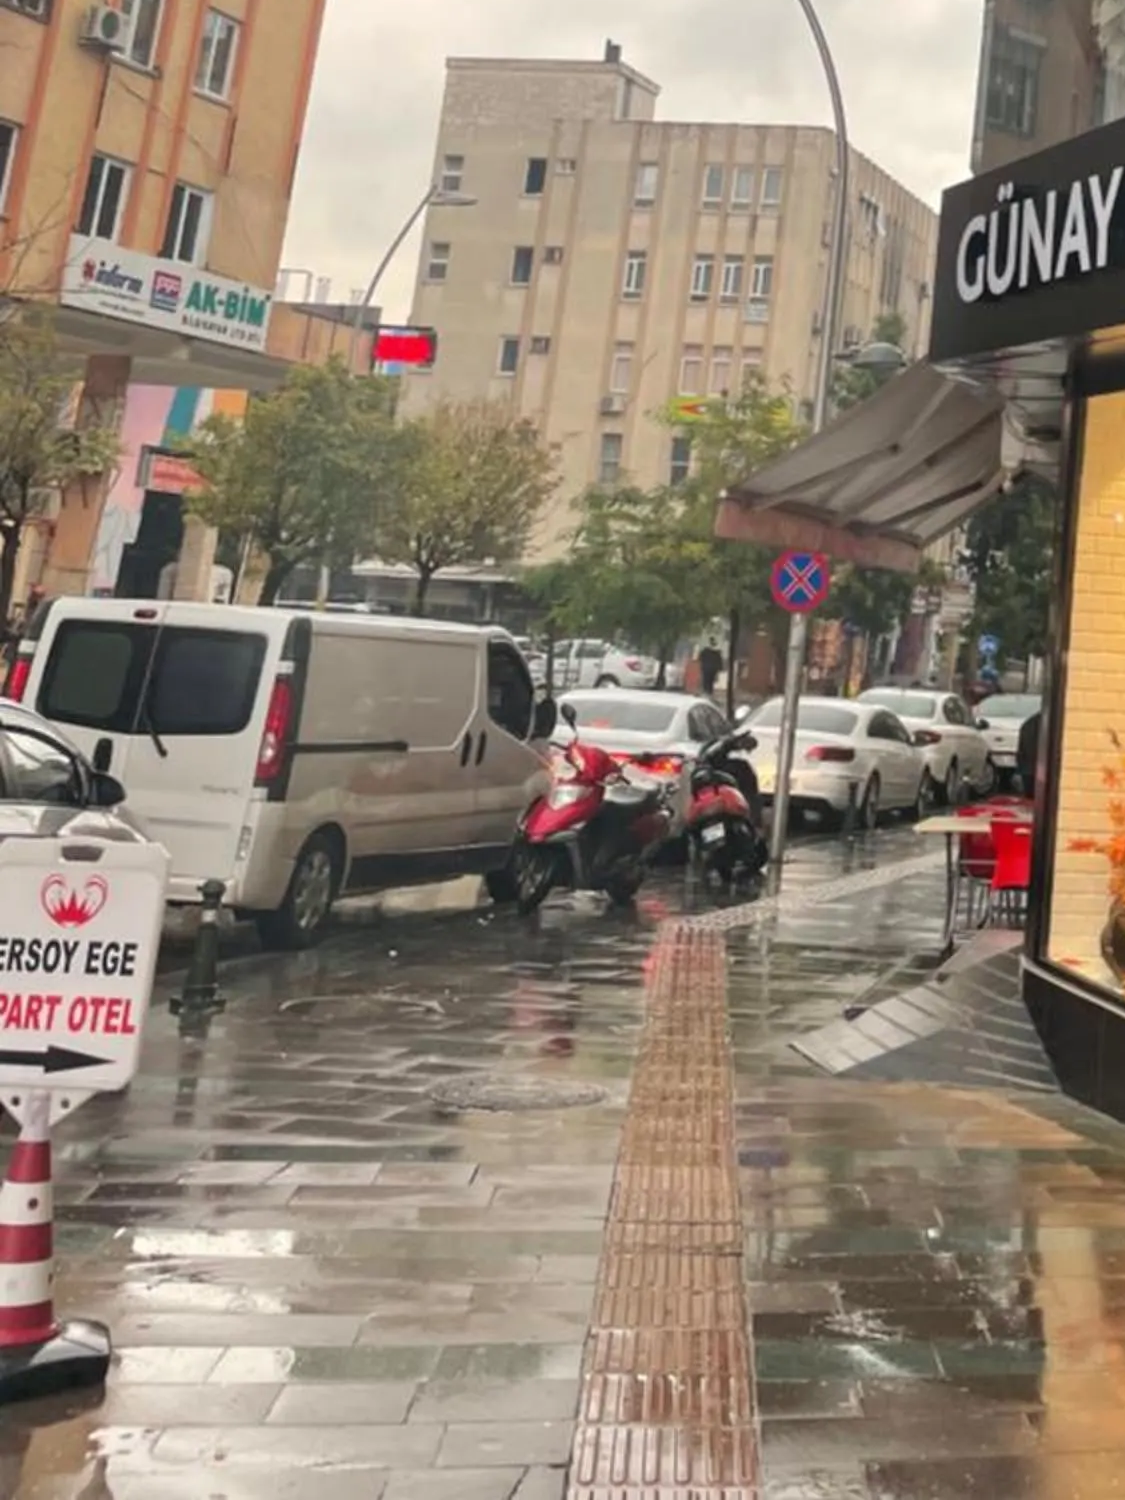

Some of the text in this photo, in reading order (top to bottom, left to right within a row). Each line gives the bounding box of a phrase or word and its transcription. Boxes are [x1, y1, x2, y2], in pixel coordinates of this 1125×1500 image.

[956, 165, 1124, 303] GÜNAY
[185, 280, 268, 328] AK-BİM
[84, 941, 138, 977] EGE
[67, 995, 136, 1035] OTEL
